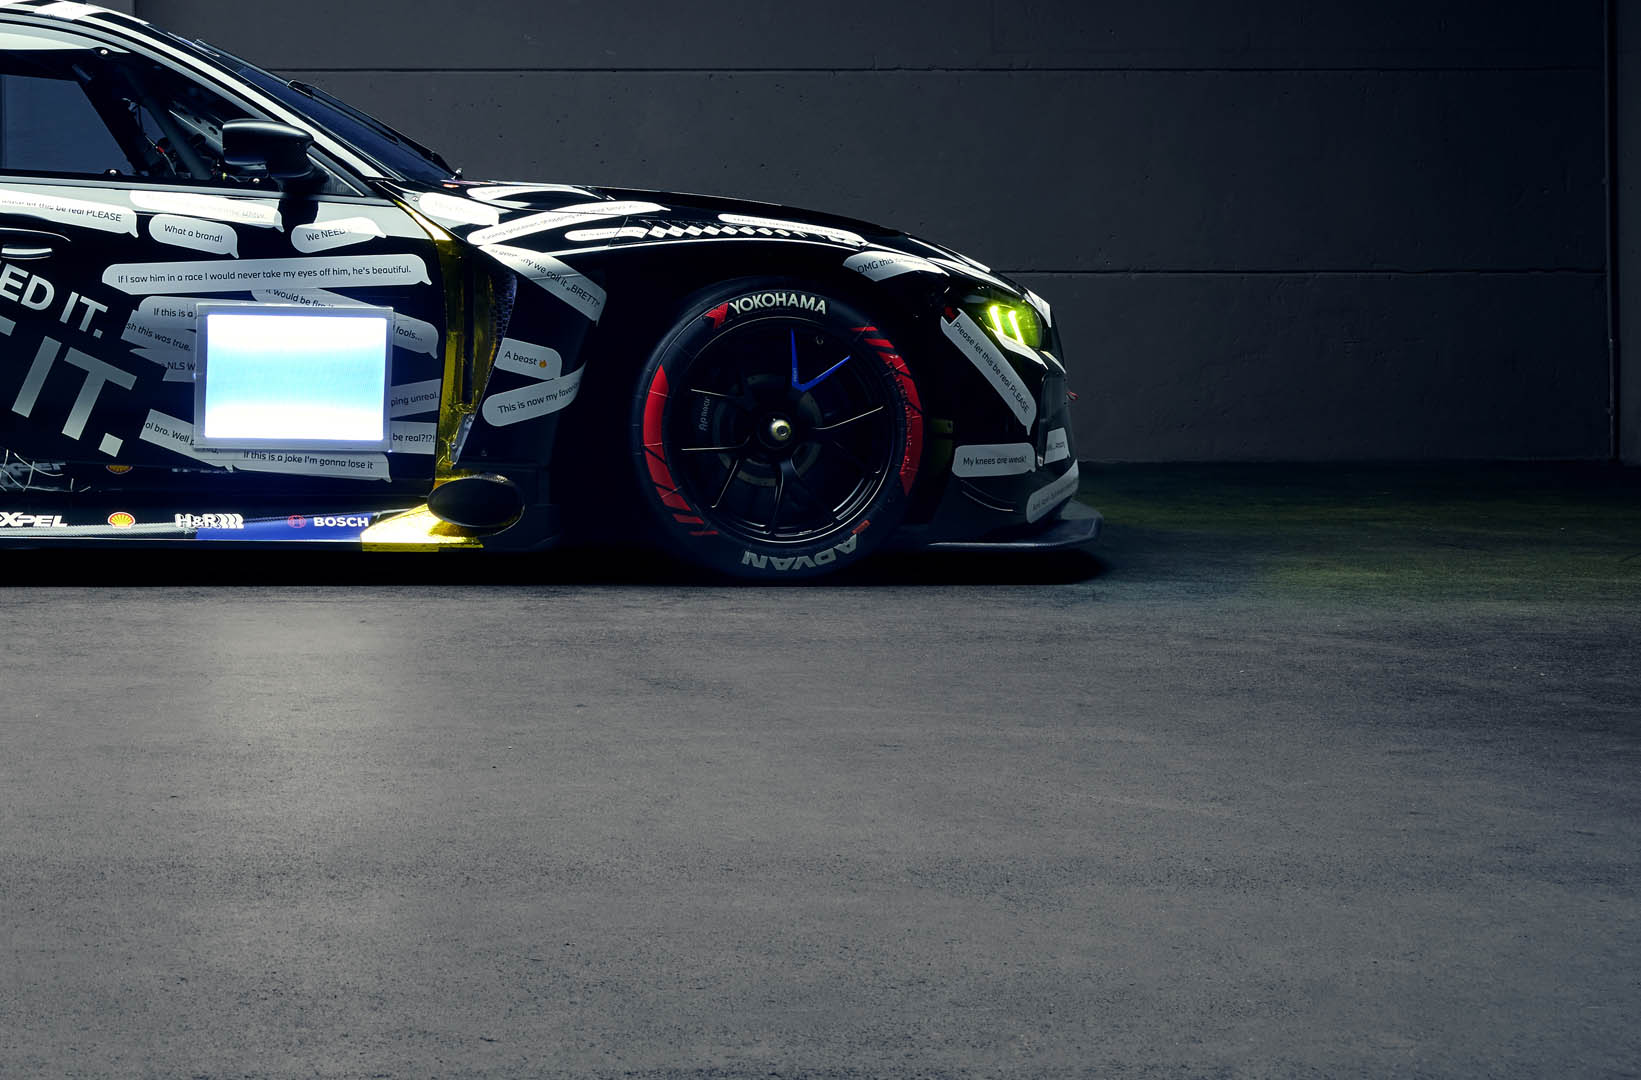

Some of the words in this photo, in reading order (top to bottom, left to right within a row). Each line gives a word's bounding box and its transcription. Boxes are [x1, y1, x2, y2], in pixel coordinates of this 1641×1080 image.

[86, 208, 123, 222] PLEASE
[164, 223, 187, 237] What
[195, 230, 224, 243] brand!
[305, 232, 320, 241] We
[149, 274, 166, 283] him
[167, 274, 176, 282] in
[209, 272, 236, 280] would
[237, 272, 261, 280] never
[262, 270, 281, 278] take
[283, 271, 295, 279] my
[297, 270, 317, 278] eyes
[319, 267, 331, 276] off
[332, 267, 351, 277] him,
[352, 266, 370, 275] he's
[371, 265, 412, 275] beautiful.
[857, 259, 879, 274] OMG
[273, 288, 299, 302] would
[300, 296, 311, 306] be
[729, 292, 827, 315] YOKOHAMA
[60, 291, 110, 339] IT.
[153, 308, 160, 316] If
[161, 308, 177, 317] this
[178, 309, 186, 318] is
[138, 325, 153, 338] this
[154, 333, 172, 344] was
[172, 338, 191, 352] true.
[504, 350, 512, 360] A
[513, 352, 537, 366] beast
[953, 321, 975, 346] Please
[974, 341, 984, 355] let
[982, 351, 993, 367] this
[992, 363, 1001, 376] be
[1000, 373, 1012, 388] real
[1009, 384, 1030, 414] PLEASE
[11, 335, 138, 458] IT.
[498, 403, 517, 415] This
[518, 400, 526, 410] is
[526, 396, 546, 407] now
[546, 392, 559, 402] my
[154, 423, 170, 437] bro.
[172, 430, 190, 443] Well
[392, 432, 404, 441] be
[251, 451, 266, 461] this
[268, 452, 276, 461] is
[284, 454, 303, 464] joke
[304, 455, 318, 465] I'm
[319, 458, 346, 467] gonna
[348, 459, 365, 469] lose
[367, 461, 374, 470] it
[963, 457, 975, 467] My
[975, 456, 996, 465] knees
[313, 516, 369, 527] BOSCH
[741, 533, 857, 571] ADVAN
